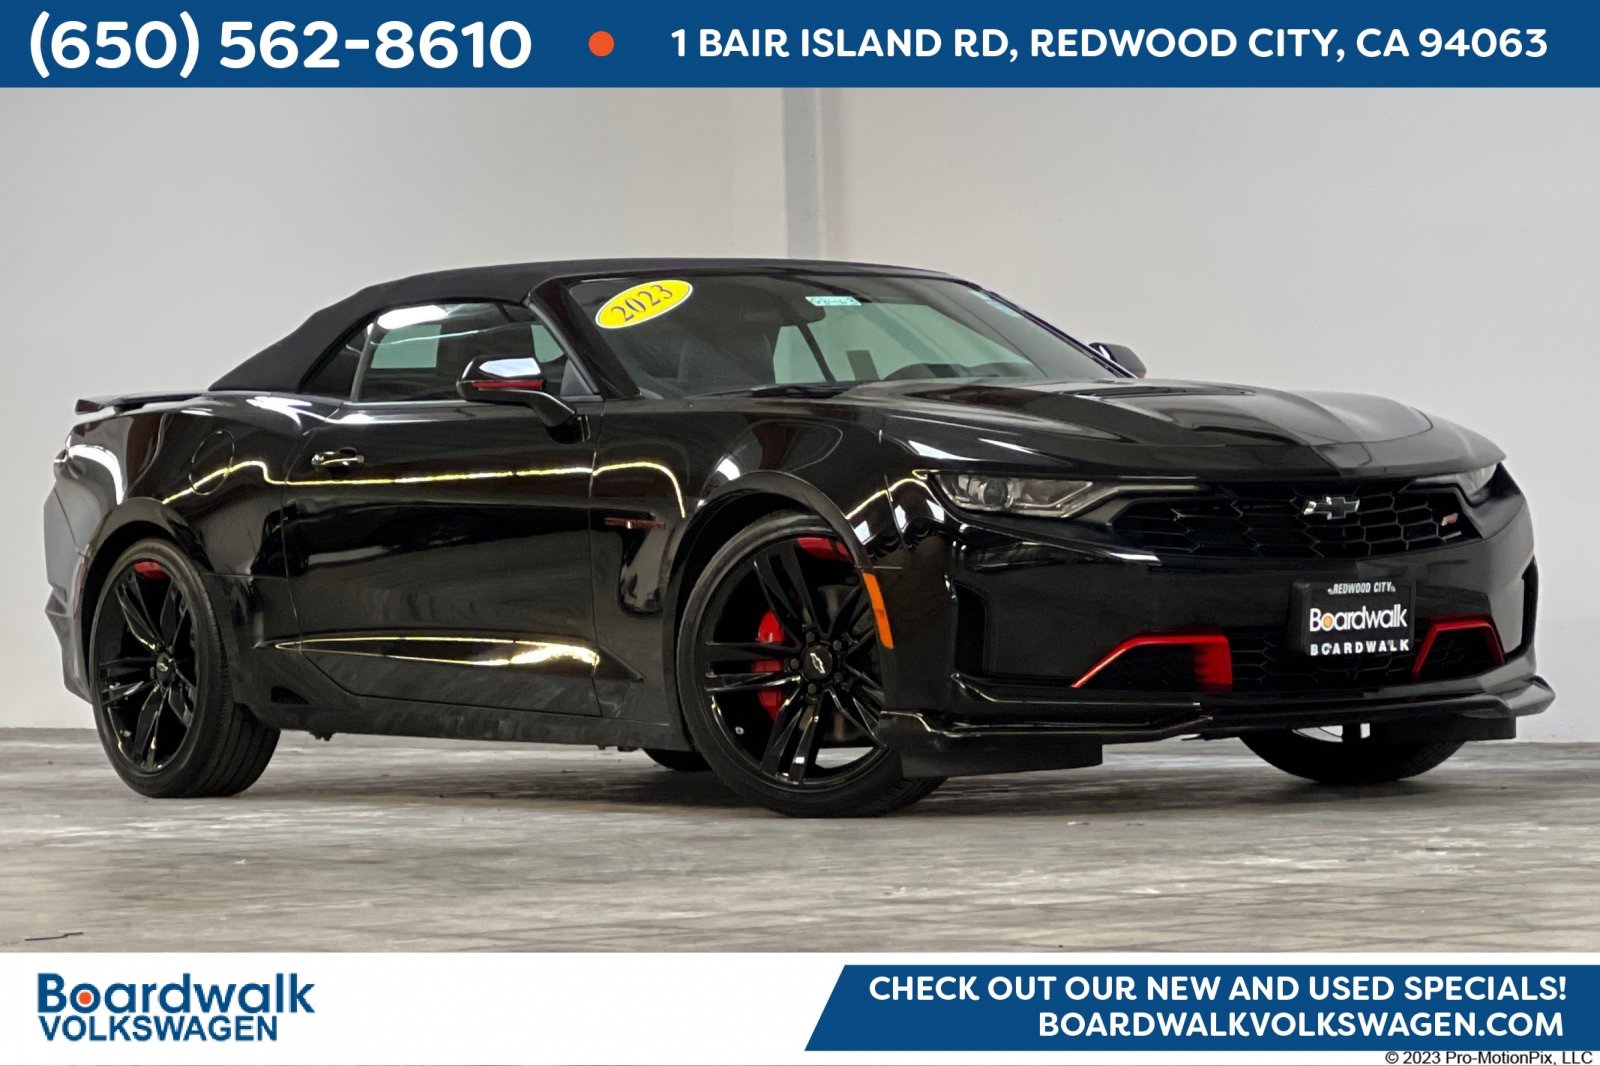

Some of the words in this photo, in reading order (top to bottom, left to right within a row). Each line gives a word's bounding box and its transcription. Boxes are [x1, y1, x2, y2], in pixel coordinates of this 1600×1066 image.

[610, 284, 673, 322] 2023
[1333, 582, 1371, 595] REDWOOD
[1373, 581, 1393, 593] CITY
[1309, 603, 1408, 632] Boardwalk
[1310, 638, 1410, 657] BOARDWALK
